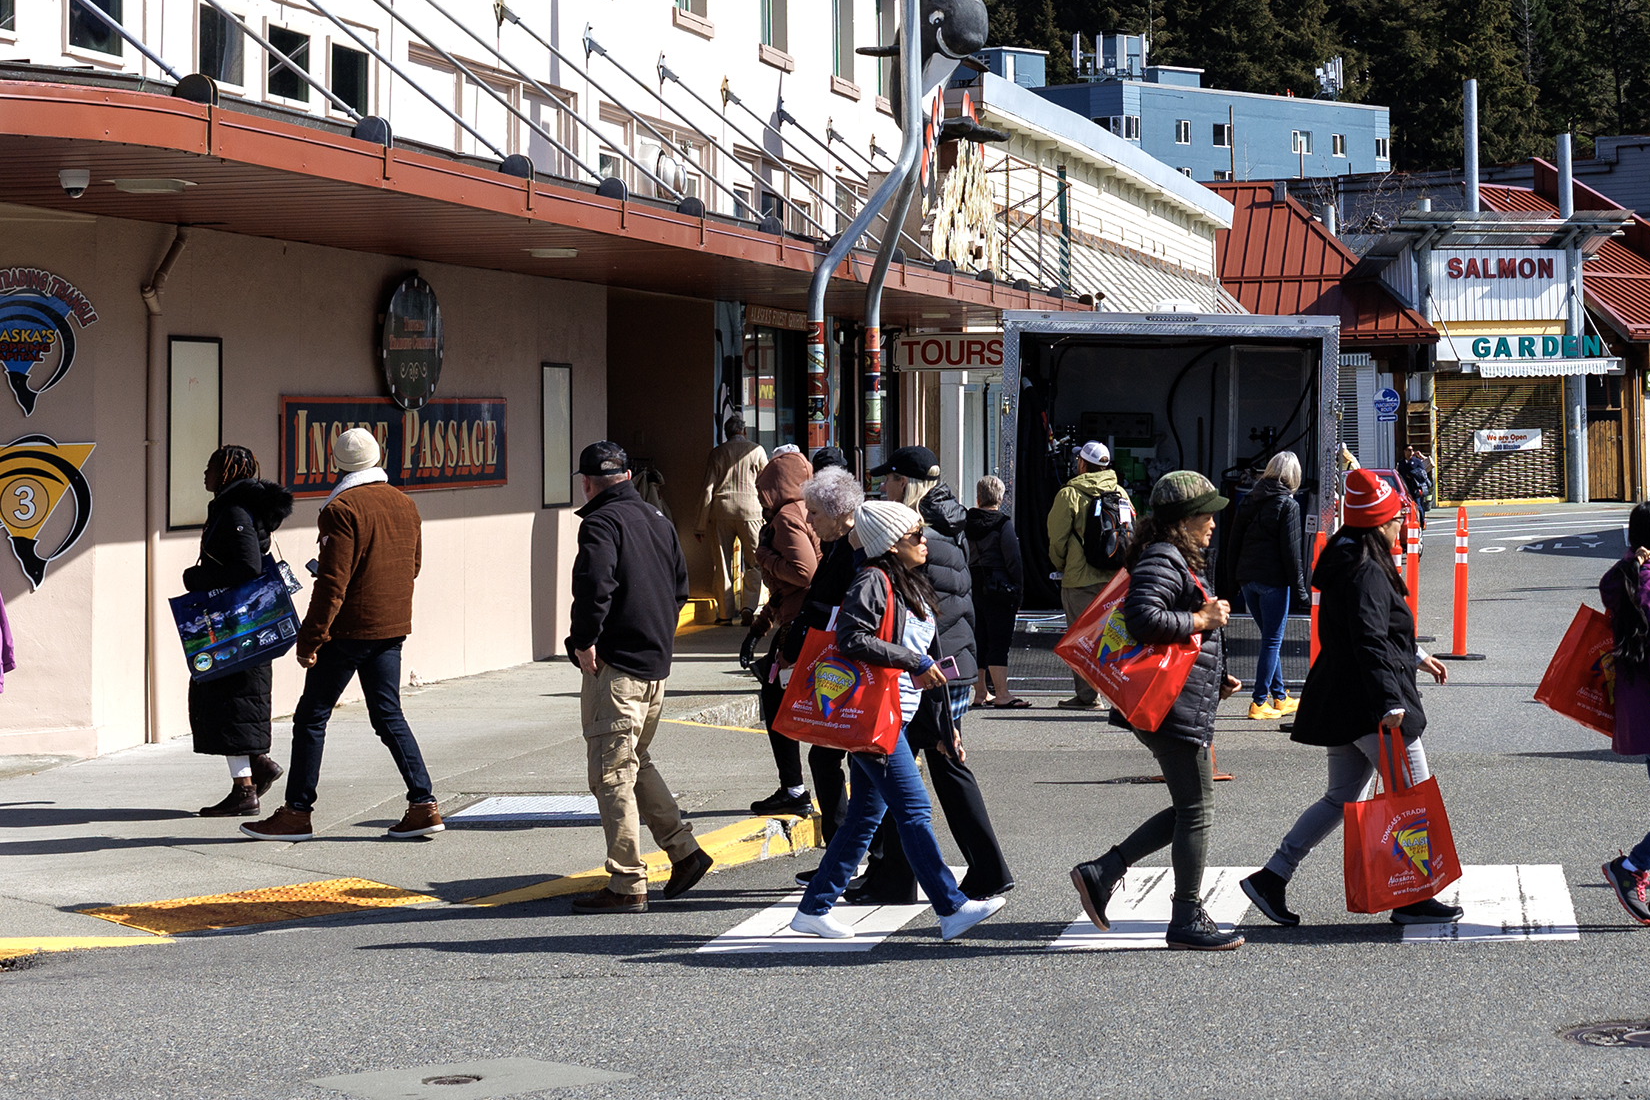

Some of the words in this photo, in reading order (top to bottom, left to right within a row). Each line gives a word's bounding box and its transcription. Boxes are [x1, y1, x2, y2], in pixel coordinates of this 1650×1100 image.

[1448, 257, 1554, 279] SALMON
[901, 339, 1003, 366] TOURS
[1472, 335, 1600, 357] GARDEN
[297, 410, 389, 474] INSE
[403, 410, 498, 470] PASSAGE
[13, 485, 36, 521] 3
[1479, 540, 1605, 553] ONLY
[1381, 814, 1401, 845] TONGASS
